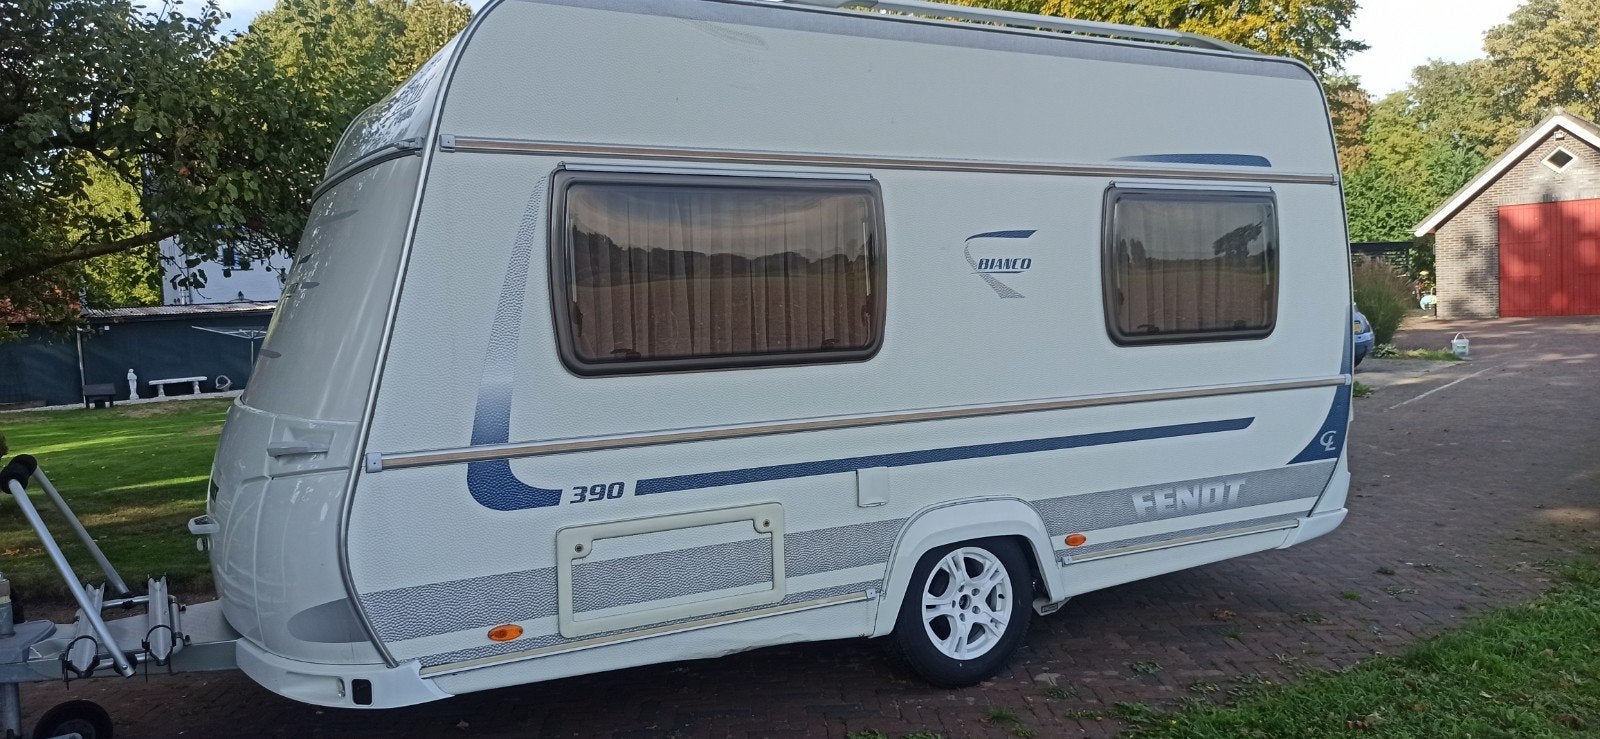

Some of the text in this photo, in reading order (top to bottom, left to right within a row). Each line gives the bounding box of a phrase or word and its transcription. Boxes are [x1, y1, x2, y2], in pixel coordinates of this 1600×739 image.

[977, 257, 1032, 270] BIANCO
[569, 481, 625, 504] 390
[1131, 479, 1246, 518] FENDT
